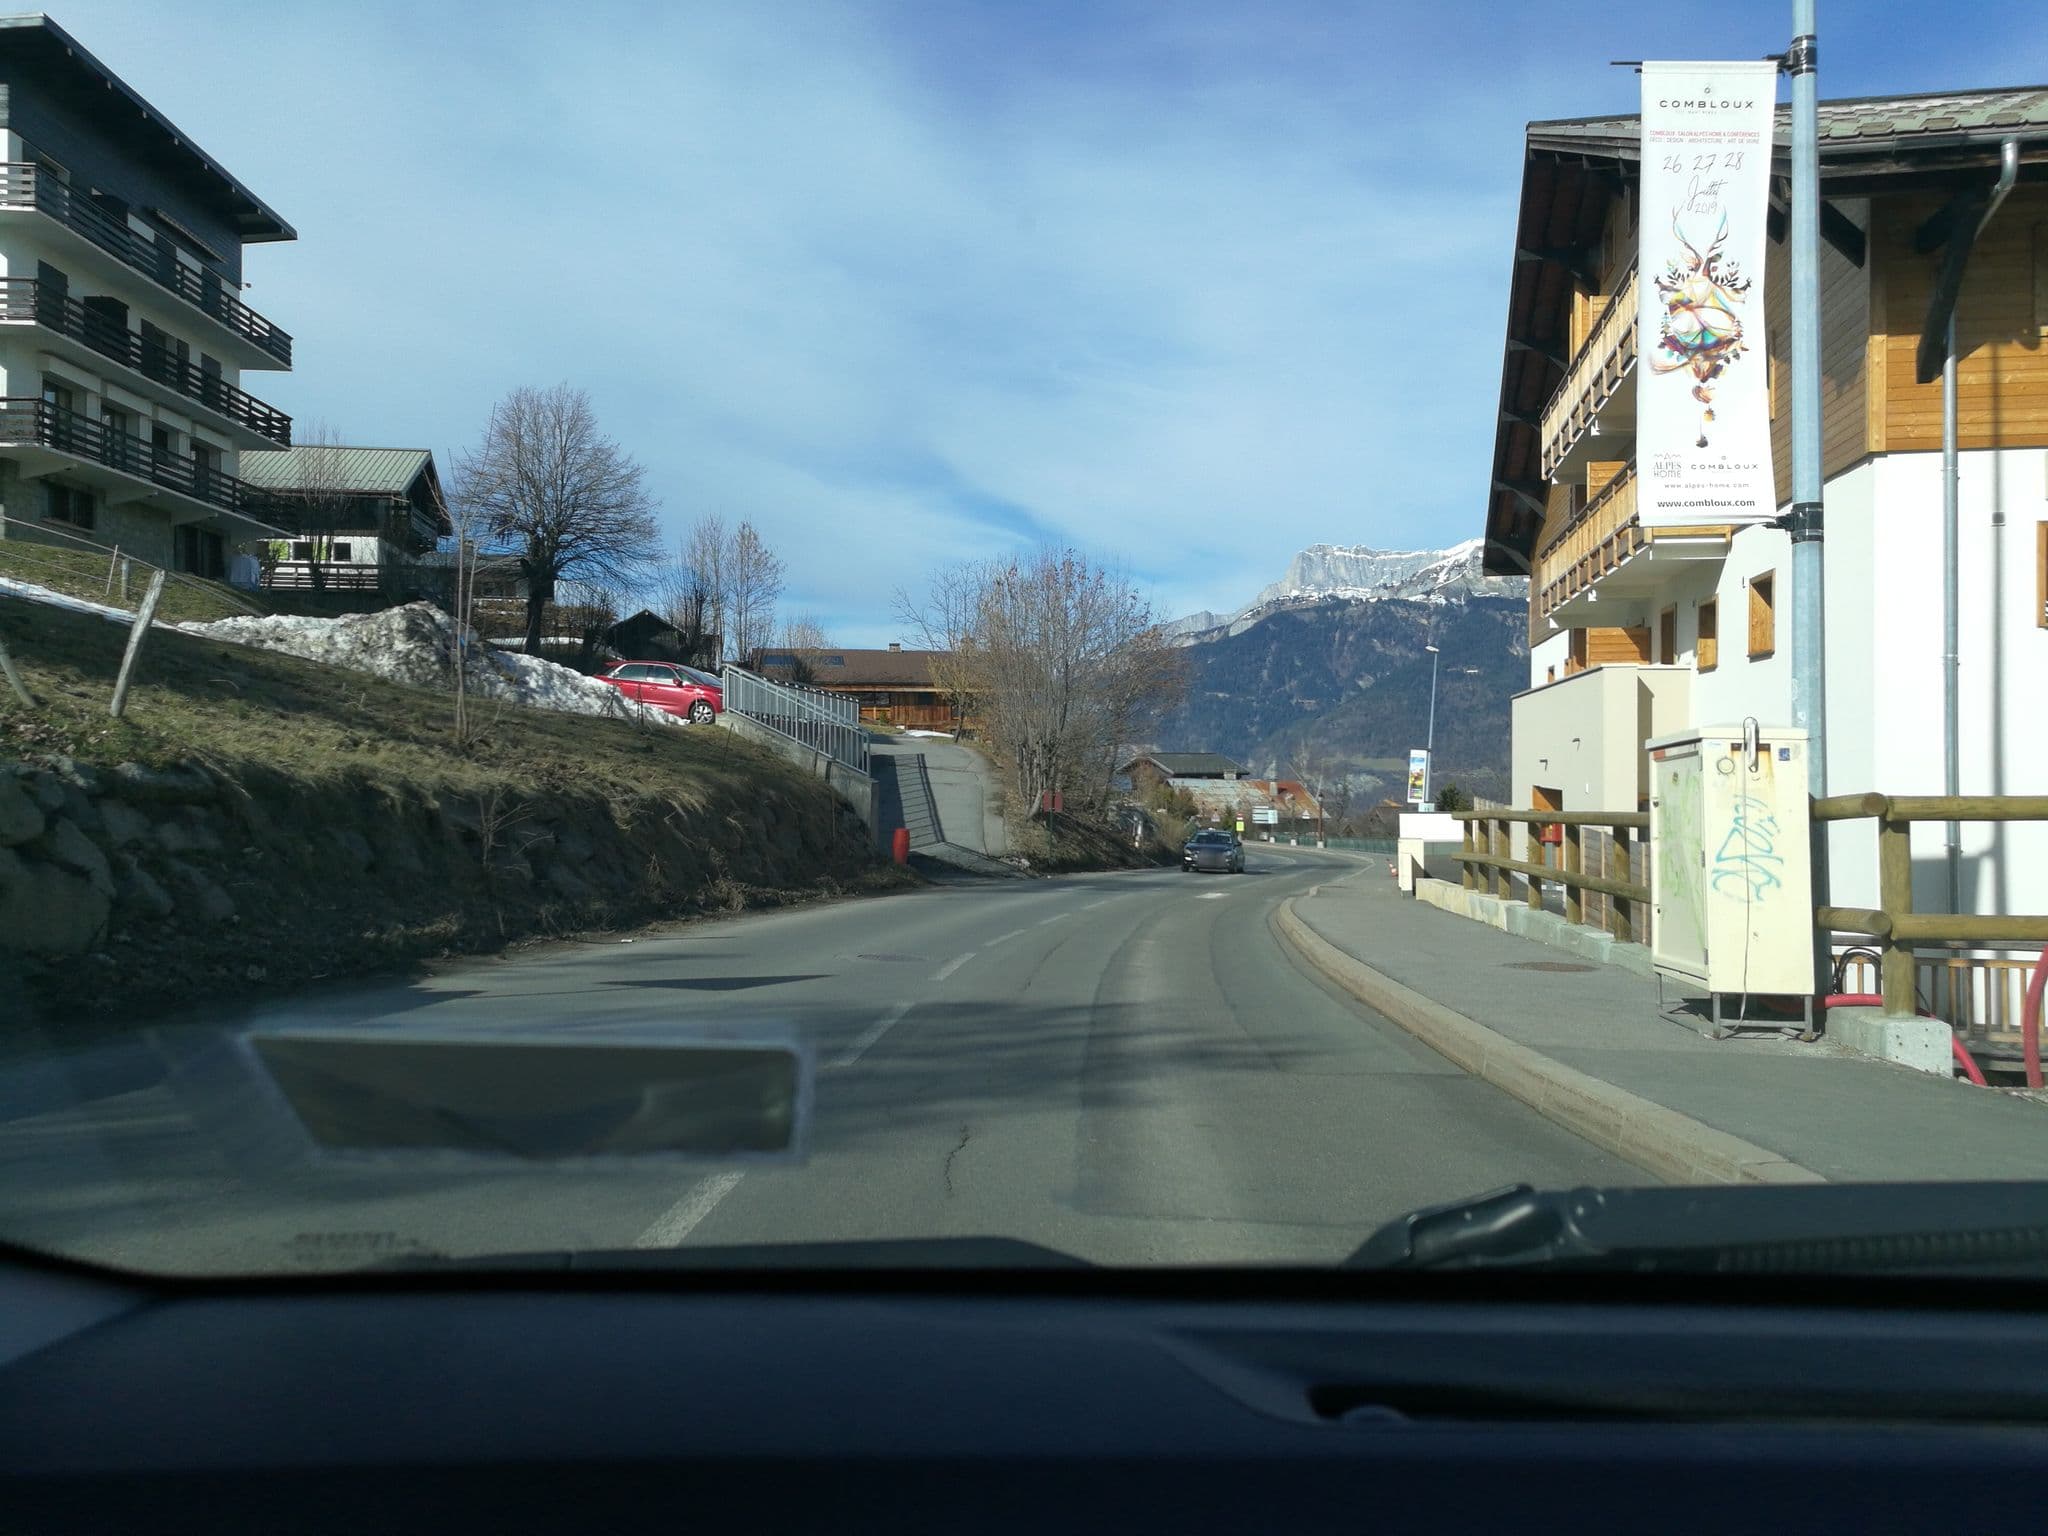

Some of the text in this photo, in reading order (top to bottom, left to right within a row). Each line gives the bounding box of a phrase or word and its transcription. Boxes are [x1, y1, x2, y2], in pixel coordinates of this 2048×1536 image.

[1659, 100, 1753, 109] COMBLOUX
[1663, 151, 1745, 174] 26 27 28
[1654, 461, 1682, 470] ALPES
[1653, 470, 1681, 478] HOME
[1657, 499, 1755, 508] www.combloux.com
